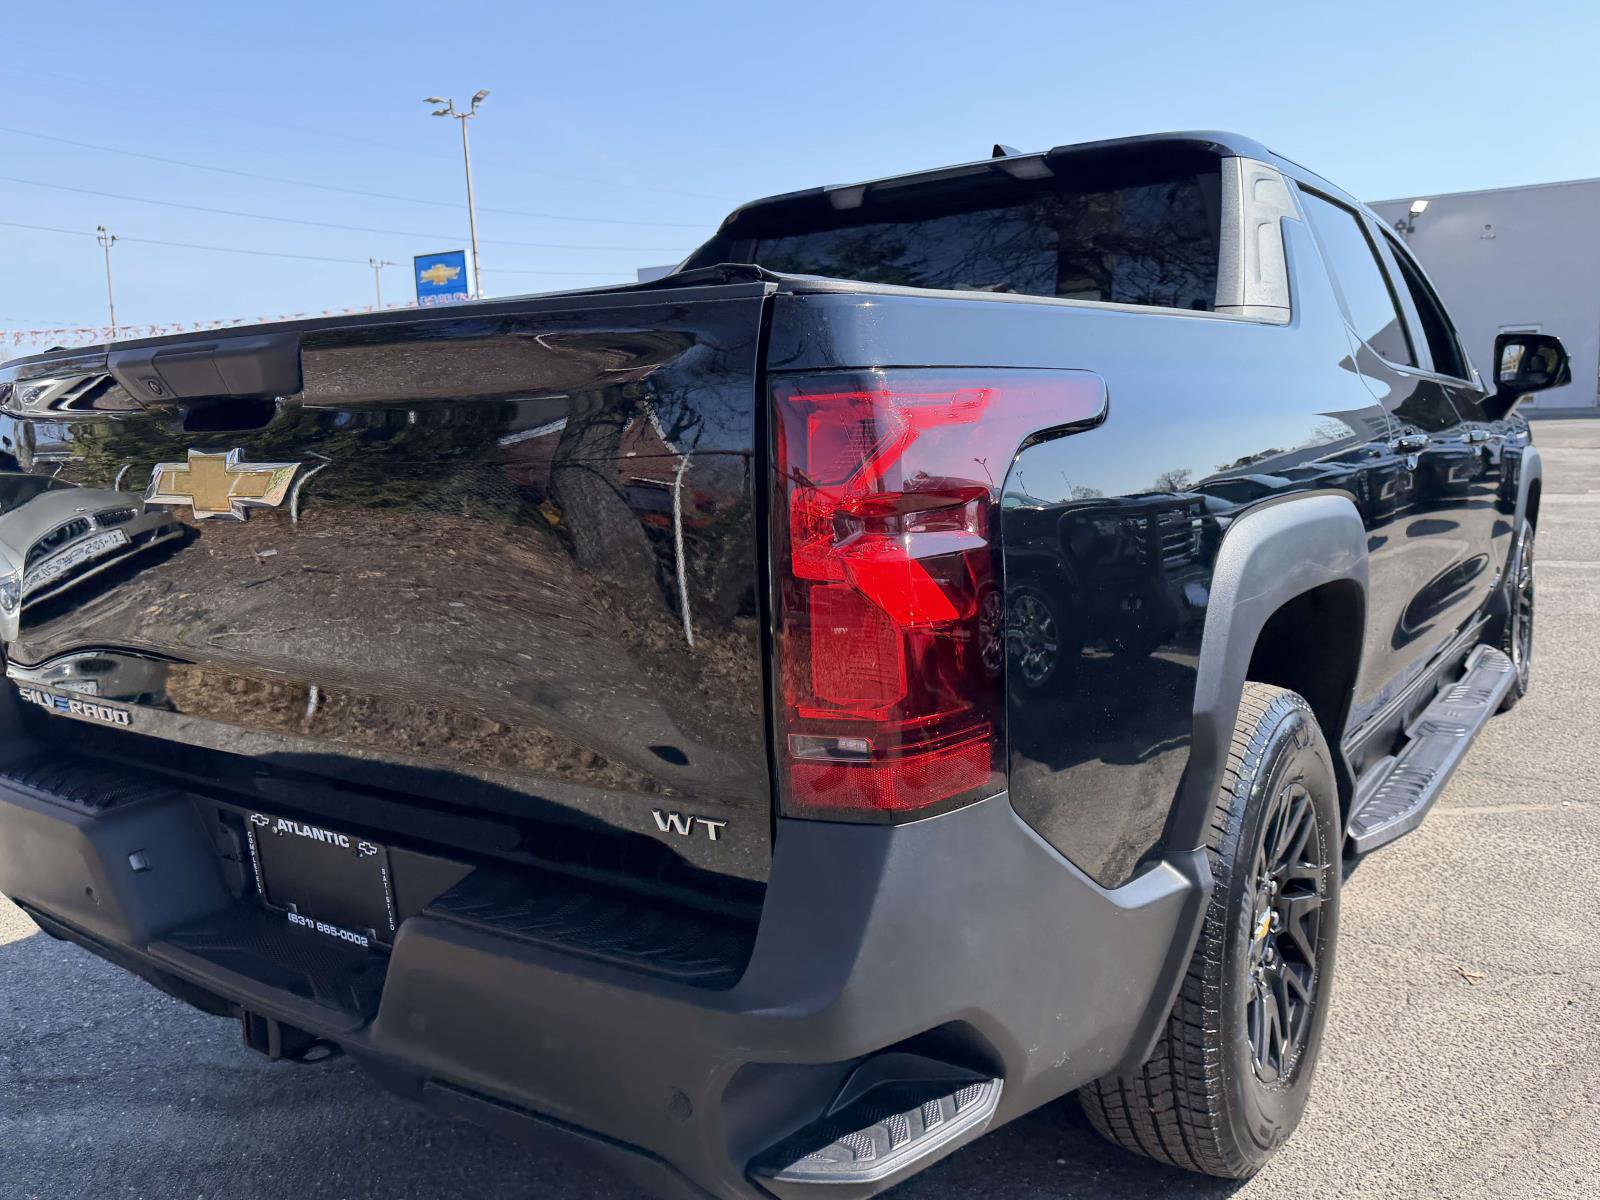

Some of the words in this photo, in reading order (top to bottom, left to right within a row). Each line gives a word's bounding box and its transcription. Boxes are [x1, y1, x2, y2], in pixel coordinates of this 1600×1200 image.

[19, 688, 130, 726] SILVERADO
[277, 818, 350, 848] ATLANTIC
[651, 807, 727, 841] WT
[287, 912, 315, 929] (631)
[316, 921, 369, 947] 665-0002
